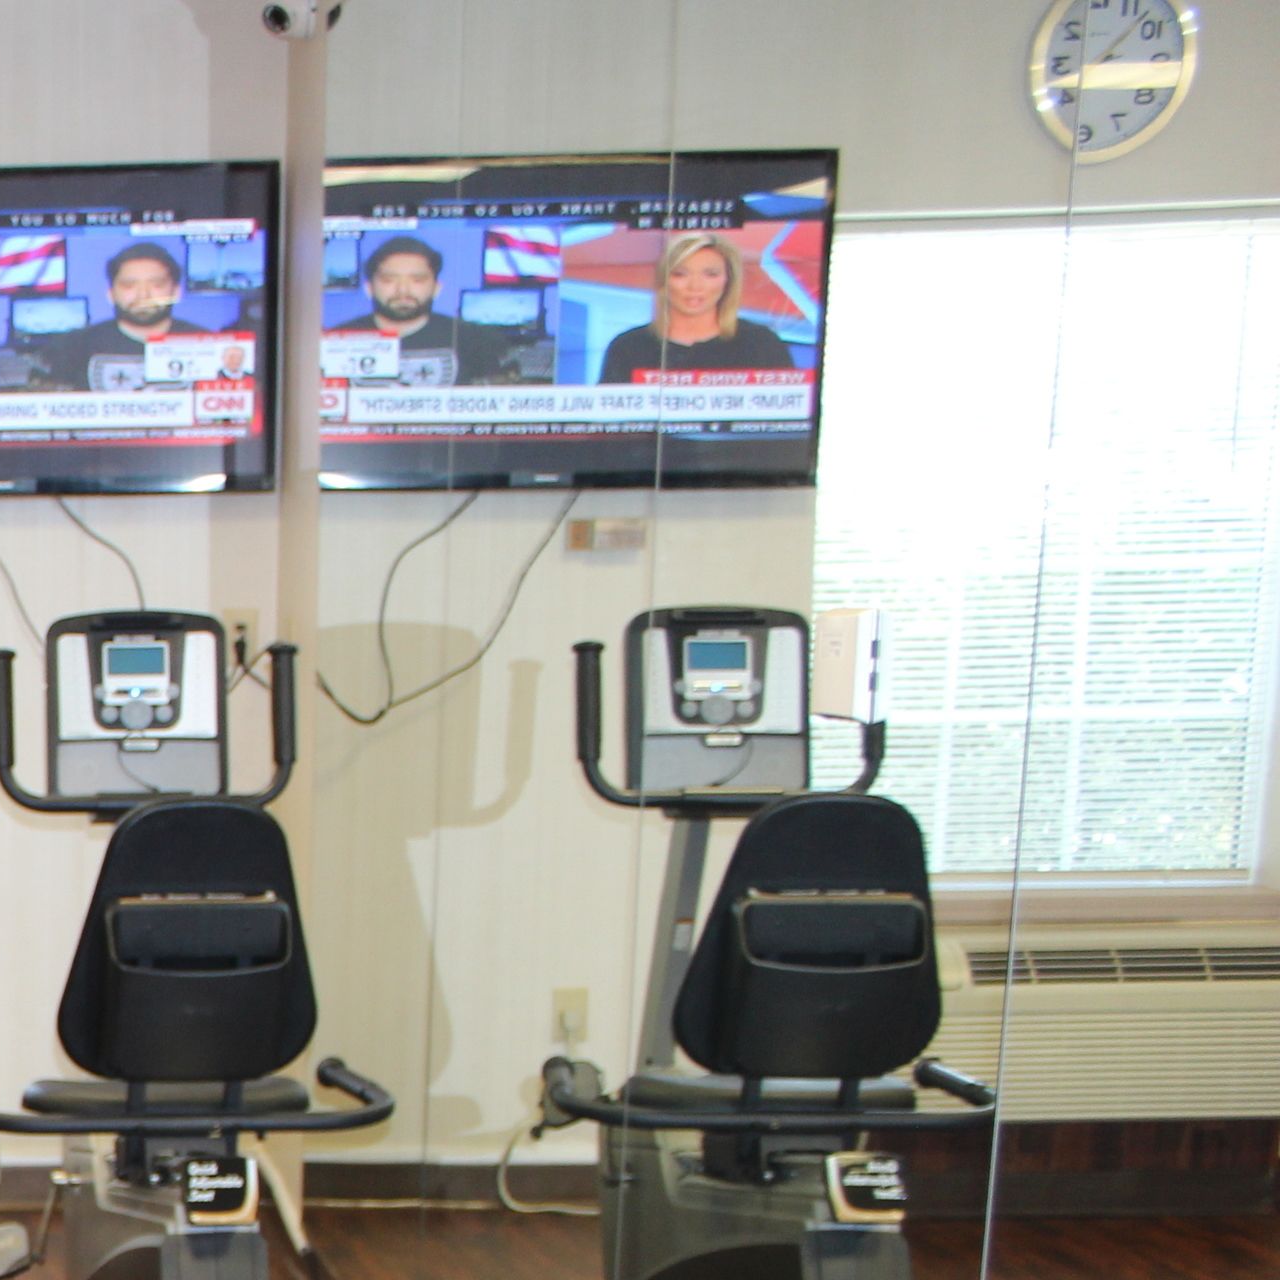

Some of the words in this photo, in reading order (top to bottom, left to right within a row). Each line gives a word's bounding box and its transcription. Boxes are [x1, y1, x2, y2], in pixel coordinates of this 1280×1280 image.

[11, 213, 43, 226] YOU
[54, 212, 76, 226] SO
[86, 211, 132, 225] MUCH
[142, 209, 175, 223] FOR
[203, 396, 244, 412] CNN
